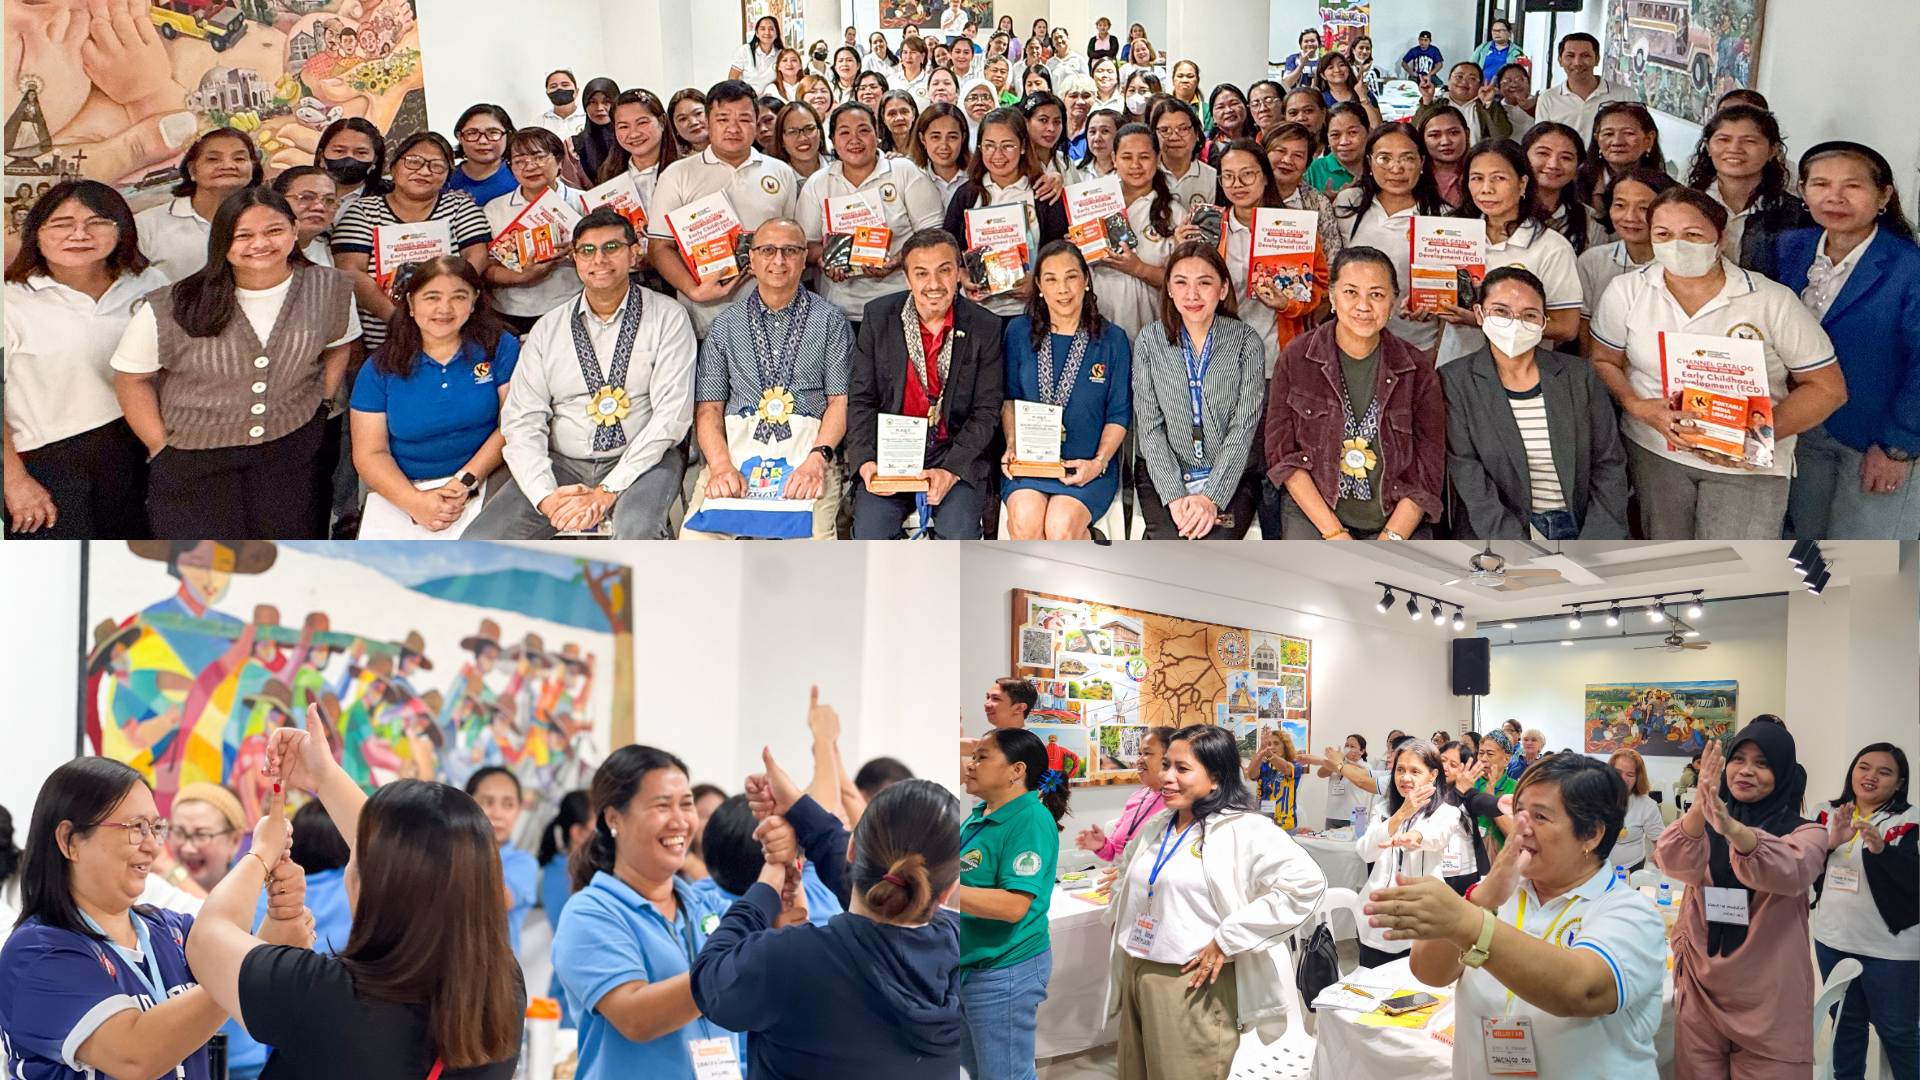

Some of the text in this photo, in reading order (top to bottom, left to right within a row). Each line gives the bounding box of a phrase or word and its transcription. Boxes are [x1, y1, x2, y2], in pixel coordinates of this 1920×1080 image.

[1091, 200, 1118, 210] Childhood
[993, 232, 1019, 240] Childhood
[1258, 242, 1294, 250] Development
[390, 252, 407, 260] Early
[409, 248, 442, 257] Childhood
[1418, 252, 1461, 260] Development
[1442, 248, 1477, 257] Childhood
[1676, 358, 1714, 368] CHANNEL
[1717, 362, 1754, 372] CATALOG
[1681, 371, 1755, 386] Early Childhood
[1674, 377, 1765, 397] Development (ECD)
[1712, 400, 1743, 411] PORTABLE
[1712, 406, 1731, 414] MEDIA
[1712, 412, 1737, 421] LIBRARY
